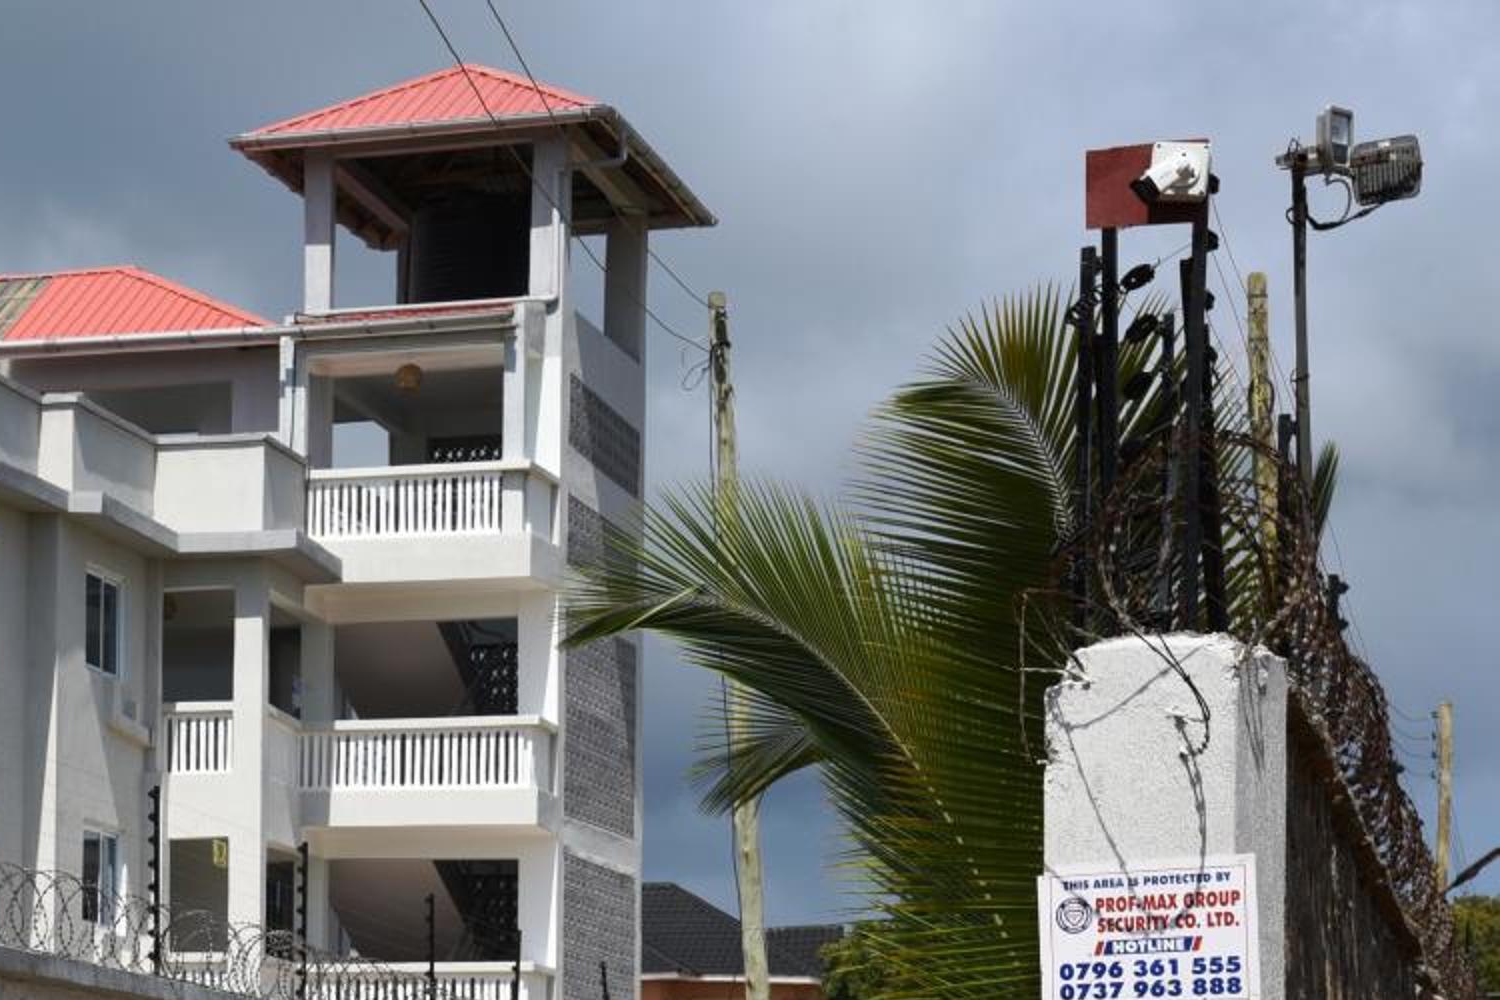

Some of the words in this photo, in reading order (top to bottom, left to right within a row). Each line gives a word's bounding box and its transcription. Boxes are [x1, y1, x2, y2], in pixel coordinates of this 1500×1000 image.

[1063, 880, 1089, 891] THIS
[1094, 878, 1124, 889] AREA
[1127, 877, 1138, 887] IS
[1143, 873, 1211, 886] PROTECTED
[1216, 872, 1231, 882] BY
[1183, 889, 1241, 909] GROUP
[1097, 914, 1169, 933] SECURITY
[1175, 913, 1201, 929] CO.
[1207, 911, 1240, 928] LTD.
[1113, 937, 1184, 954] HOTLINE
[1059, 961, 1123, 981] 0796
[1133, 958, 1179, 977] 361
[1191, 955, 1242, 975] 555
[1059, 981, 1125, 1000] 0737
[1133, 979, 1182, 998] 963
[1192, 976, 1243, 995] 888
